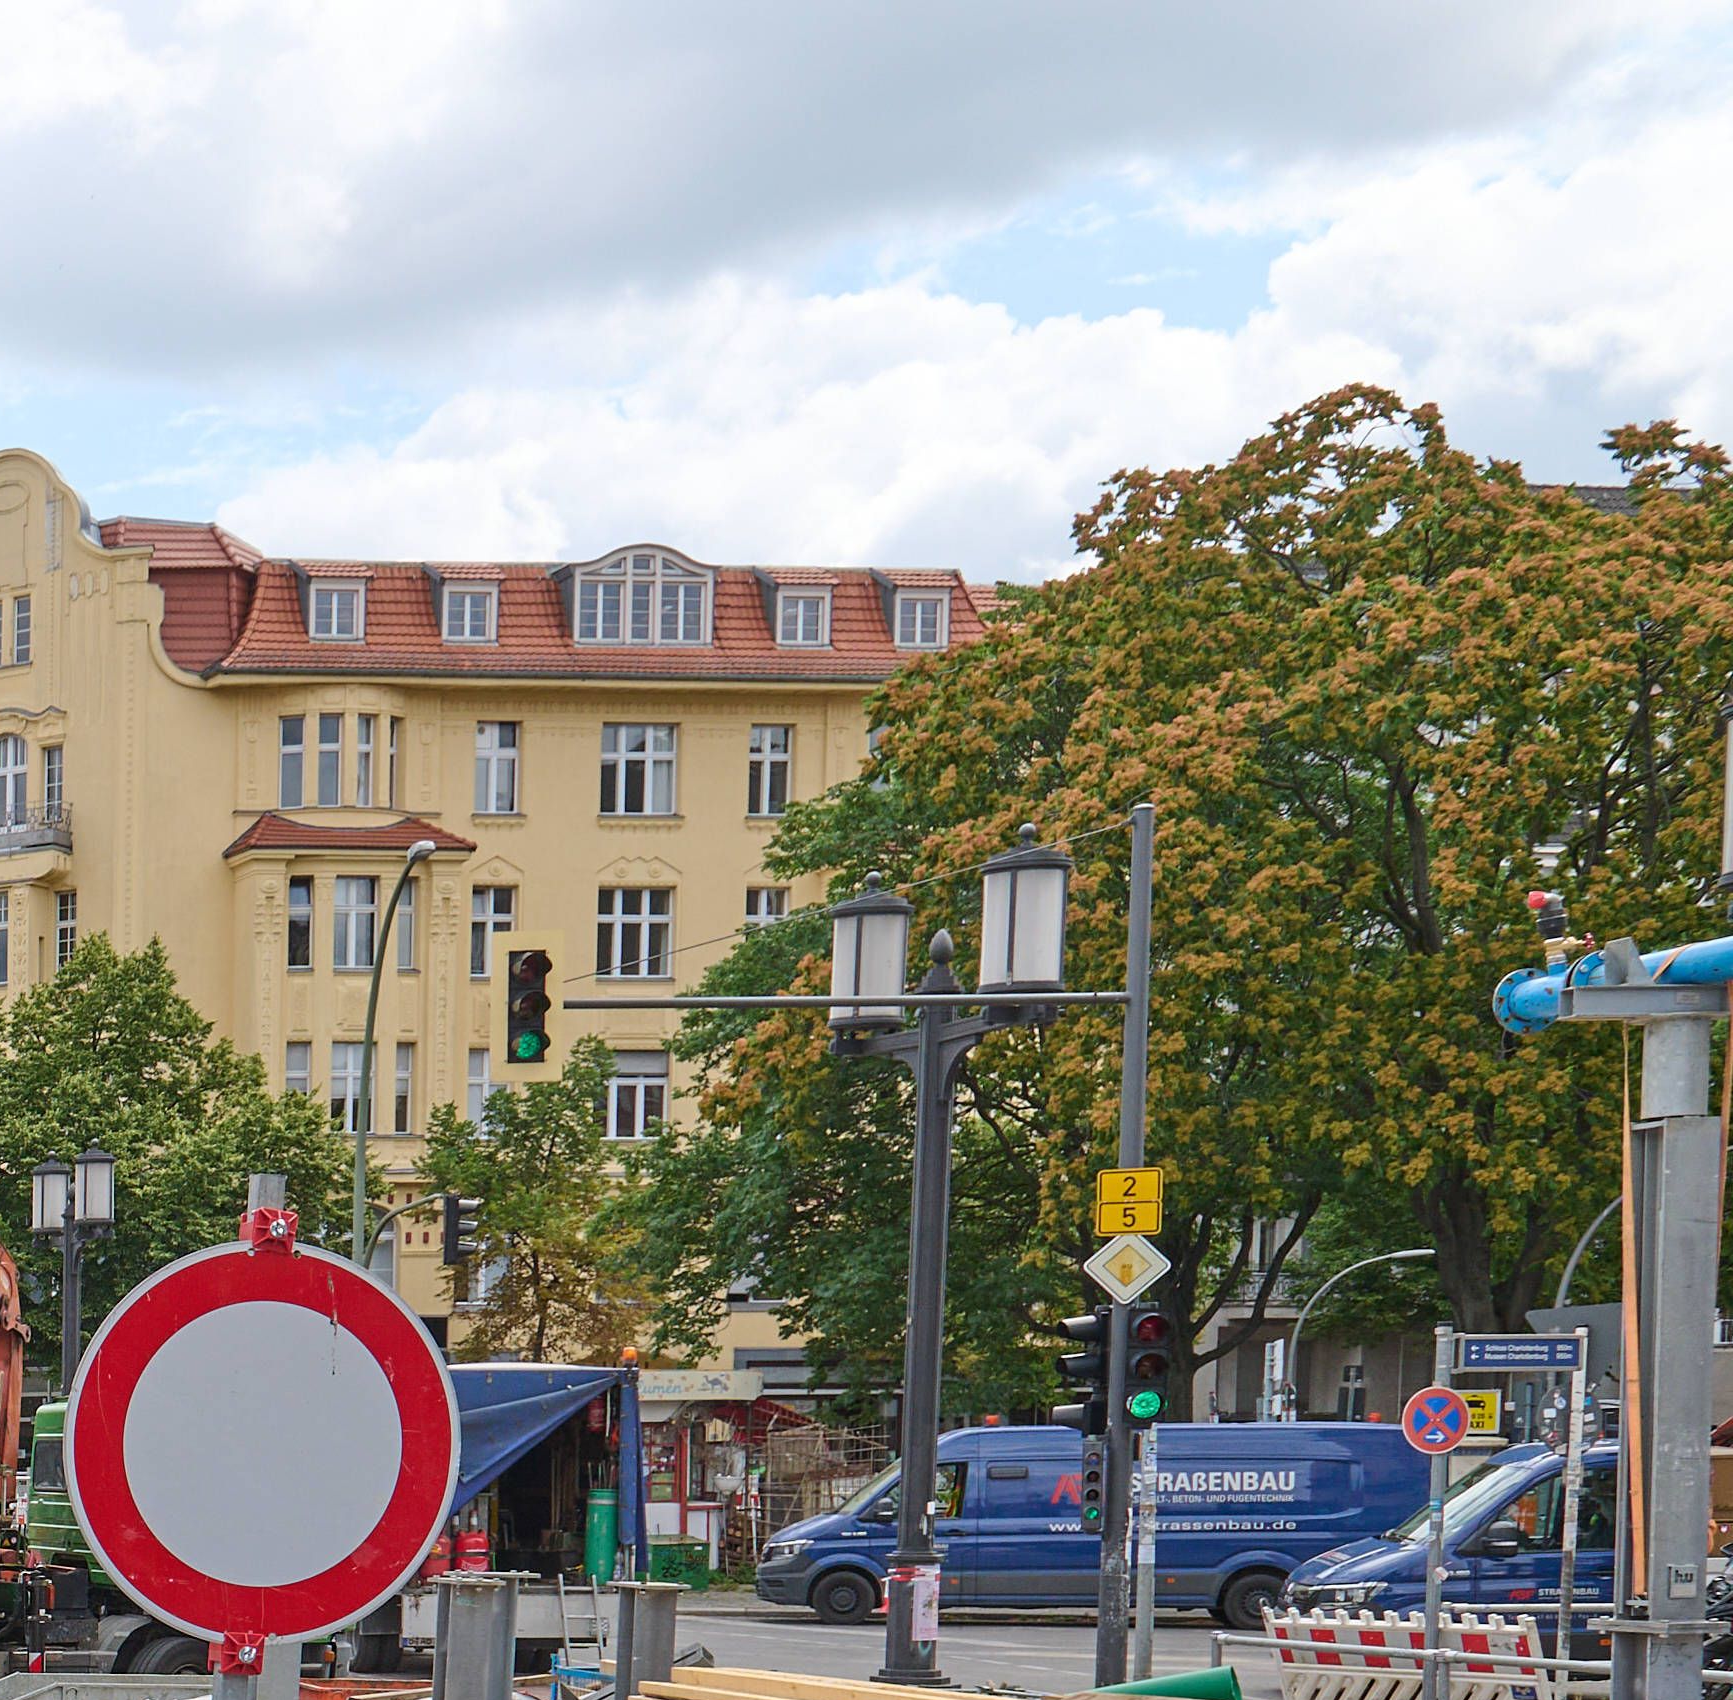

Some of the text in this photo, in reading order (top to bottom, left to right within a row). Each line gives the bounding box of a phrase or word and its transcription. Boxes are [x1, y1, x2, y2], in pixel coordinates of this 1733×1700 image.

[1123, 1177, 1137, 1197] 2
[1123, 1208, 1136, 1228] 5
[1132, 1471, 1296, 1493] SRAßENBAU
[1173, 1494, 1204, 1503] BETON-
[1206, 1494, 1226, 1503] UND
[1227, 1494, 1294, 1503] FUGENTECHNIK
[1538, 1587, 1600, 1597] STRANBAU
